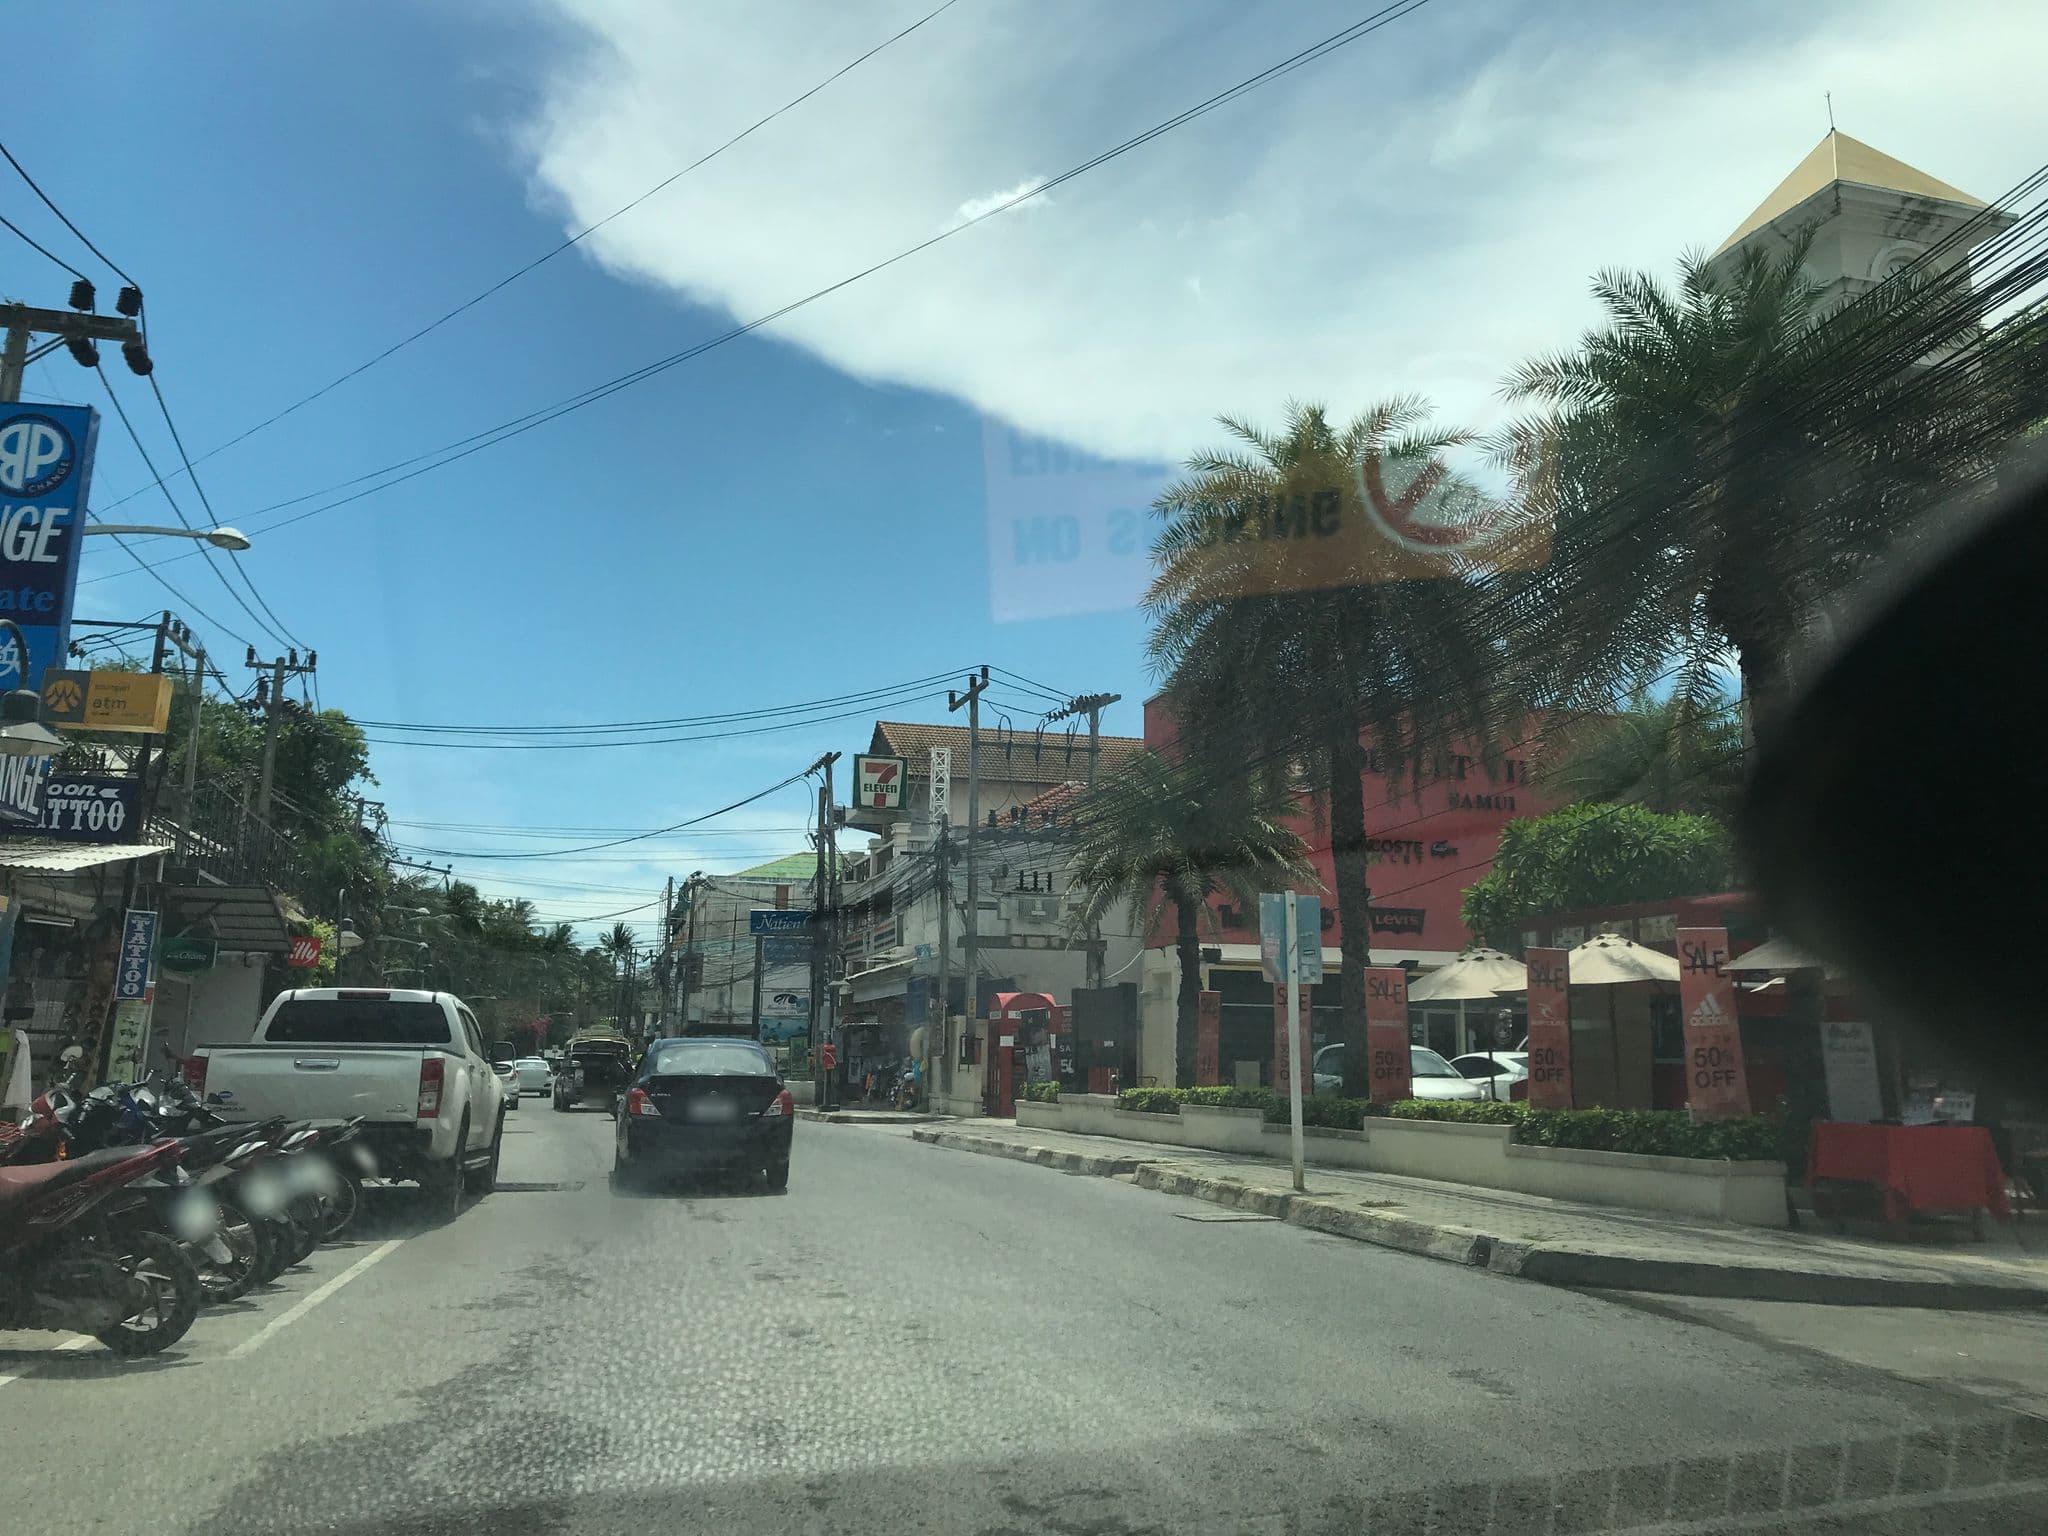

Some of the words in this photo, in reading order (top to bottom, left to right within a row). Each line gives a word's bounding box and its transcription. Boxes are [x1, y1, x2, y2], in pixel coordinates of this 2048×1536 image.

[47, 783, 97, 797] oon
[122, 918, 152, 996] TATTOO
[290, 941, 318, 963] illy
[1682, 941, 1728, 977] SALE
[1531, 960, 1565, 992] SALE
[1277, 987, 1308, 1011] SE
[1368, 976, 1404, 1004] SALE
[1374, 1067, 1404, 1081] OFF
[1534, 1067, 1565, 1083] OFF
[1695, 1070, 1736, 1089] OFF
